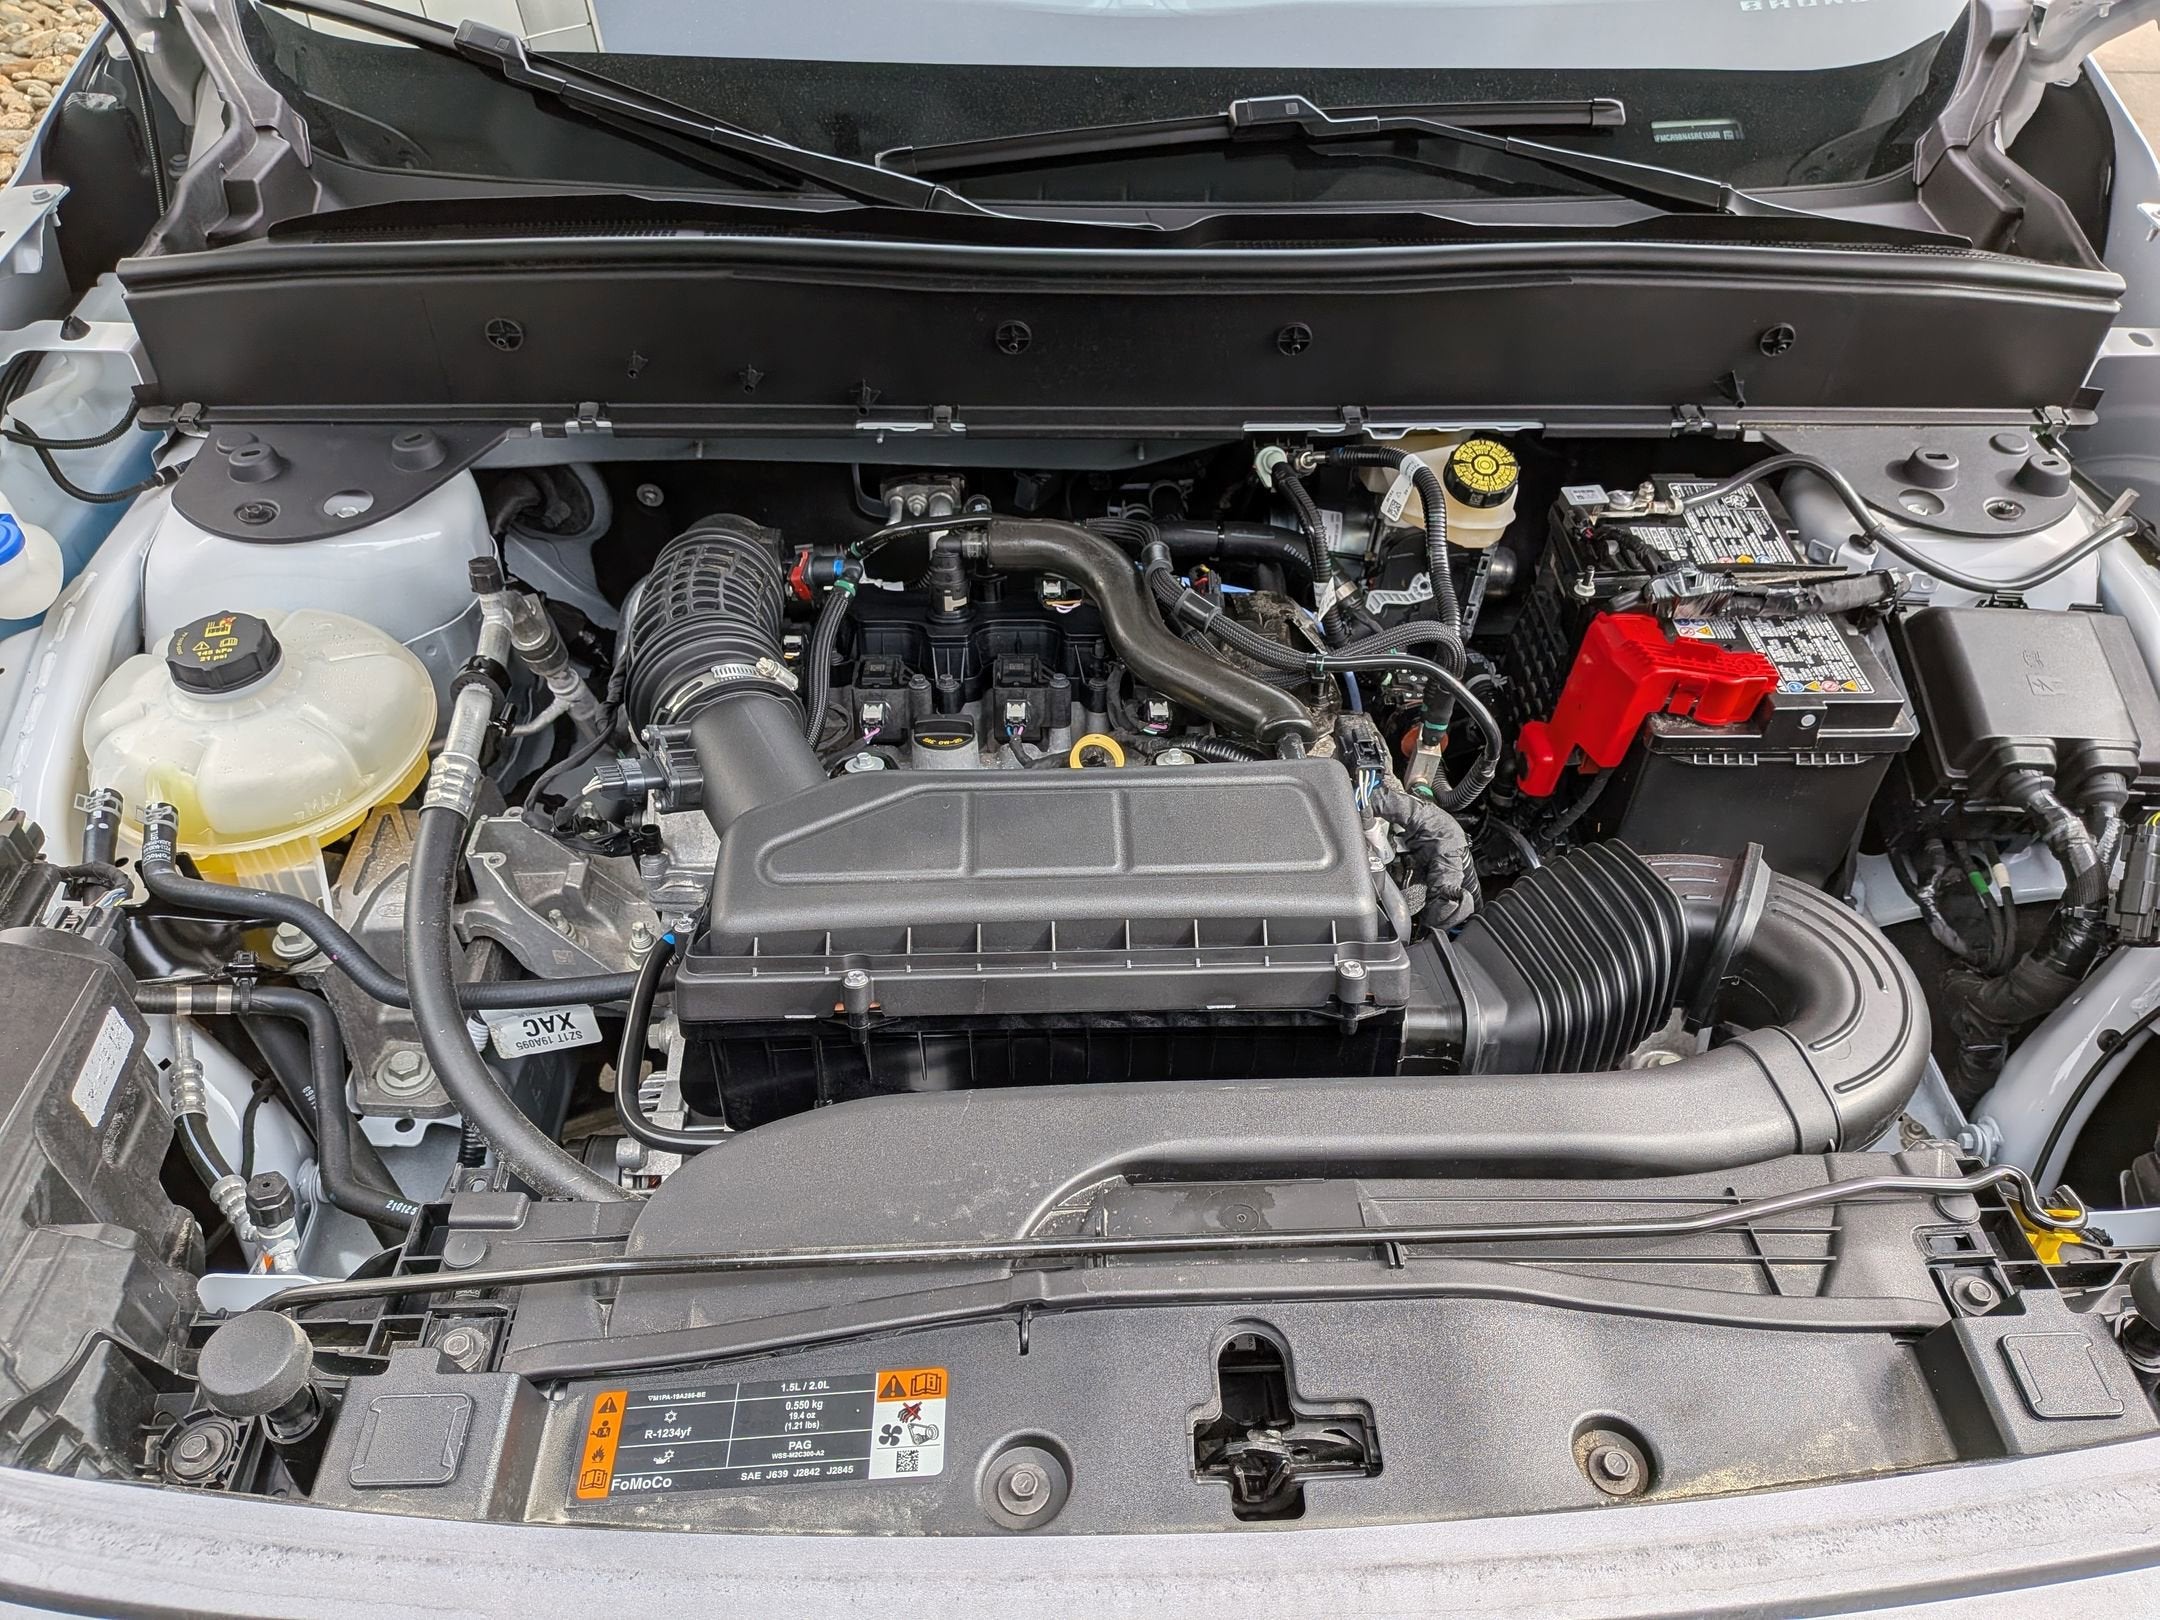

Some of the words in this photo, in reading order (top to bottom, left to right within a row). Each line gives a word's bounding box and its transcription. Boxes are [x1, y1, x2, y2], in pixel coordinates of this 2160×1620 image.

[523, 1011, 576, 1037] XAC
[515, 1035, 554, 1051] 19A095
[558, 1030, 583, 1044] SZ1T
[385, 1199, 418, 1216] 210125
[781, 1382, 802, 1392] 1.5L
[808, 1380, 830, 1390] 2.0L
[785, 1400, 810, 1411] 0.550
[811, 1400, 823, 1411] kg
[789, 1411, 805, 1420] 19.4
[644, 1426, 692, 1439] R-1234yf
[784, 1421, 803, 1432] (1.21
[804, 1420, 820, 1430] lbs)
[788, 1440, 812, 1451] PAG
[740, 1471, 761, 1481] SAE
[766, 1469, 789, 1479] J639
[793, 1467, 820, 1477] J2842
[826, 1465, 854, 1475] J2845
[611, 1475, 673, 1491] FoMoCo
